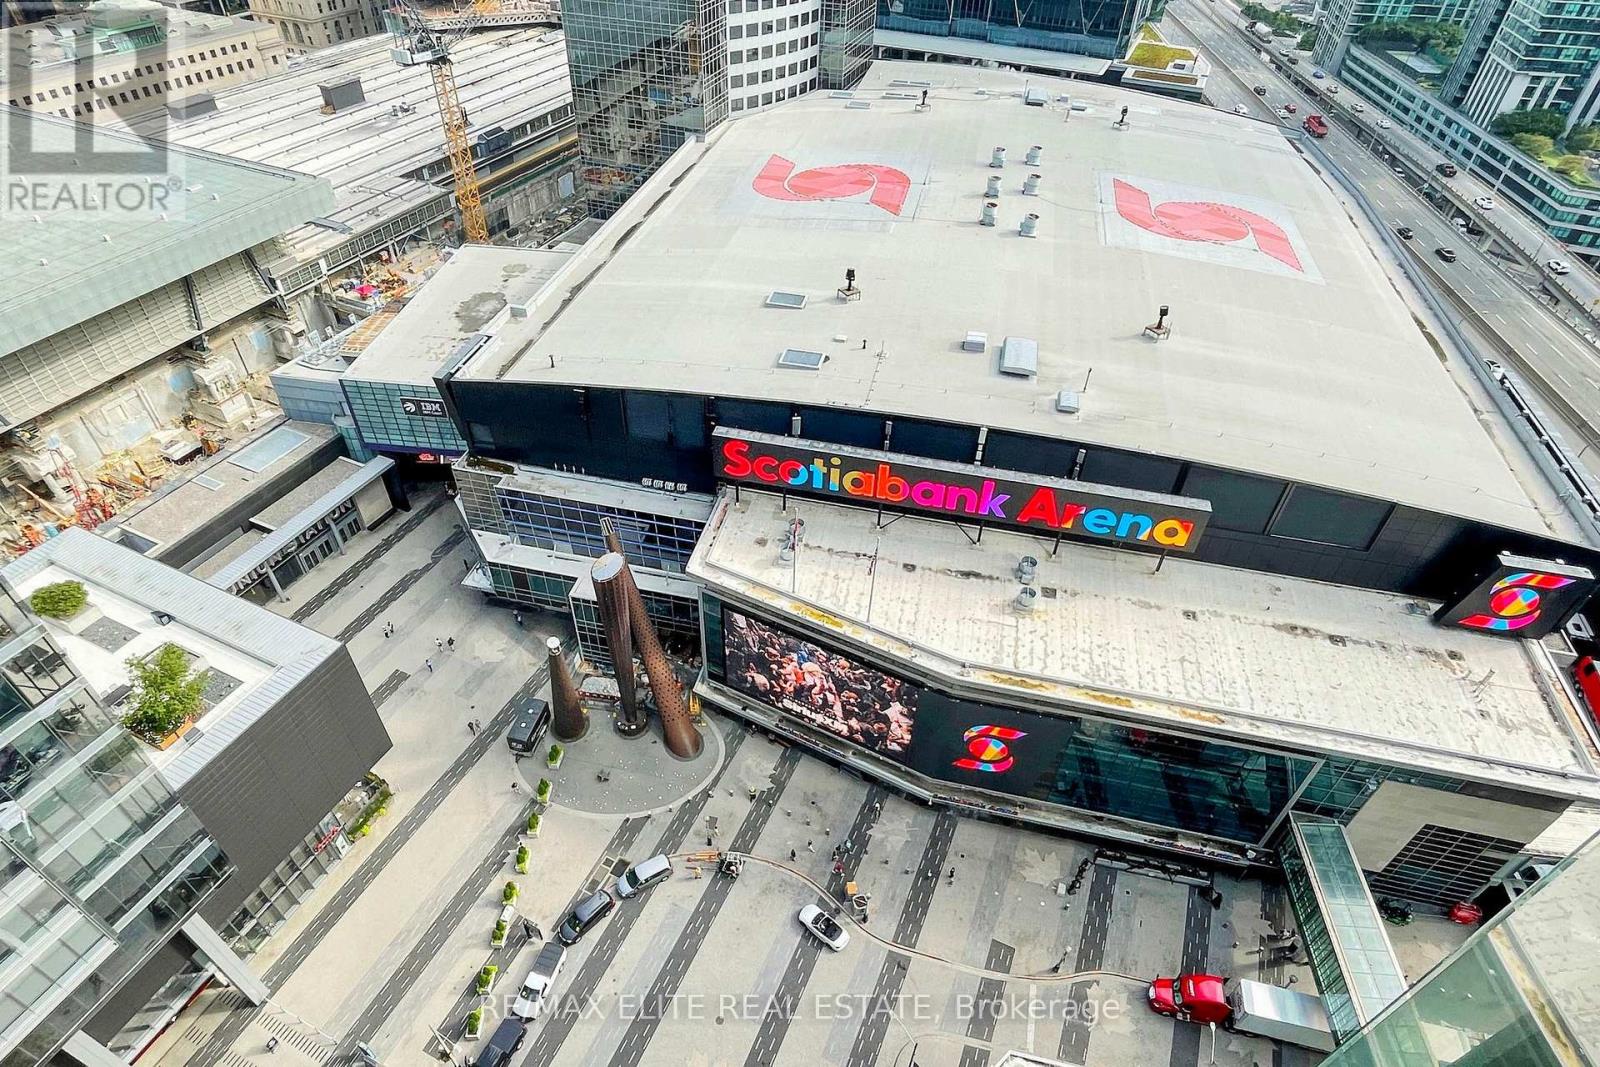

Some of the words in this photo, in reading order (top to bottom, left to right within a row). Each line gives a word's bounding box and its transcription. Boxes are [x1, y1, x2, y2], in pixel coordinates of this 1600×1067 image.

[420, 402, 441, 412] IBM
[722, 440, 1011, 519] Scotiabank
[1016, 487, 1195, 547] Arena
[283, 498, 353, 553] STATON
